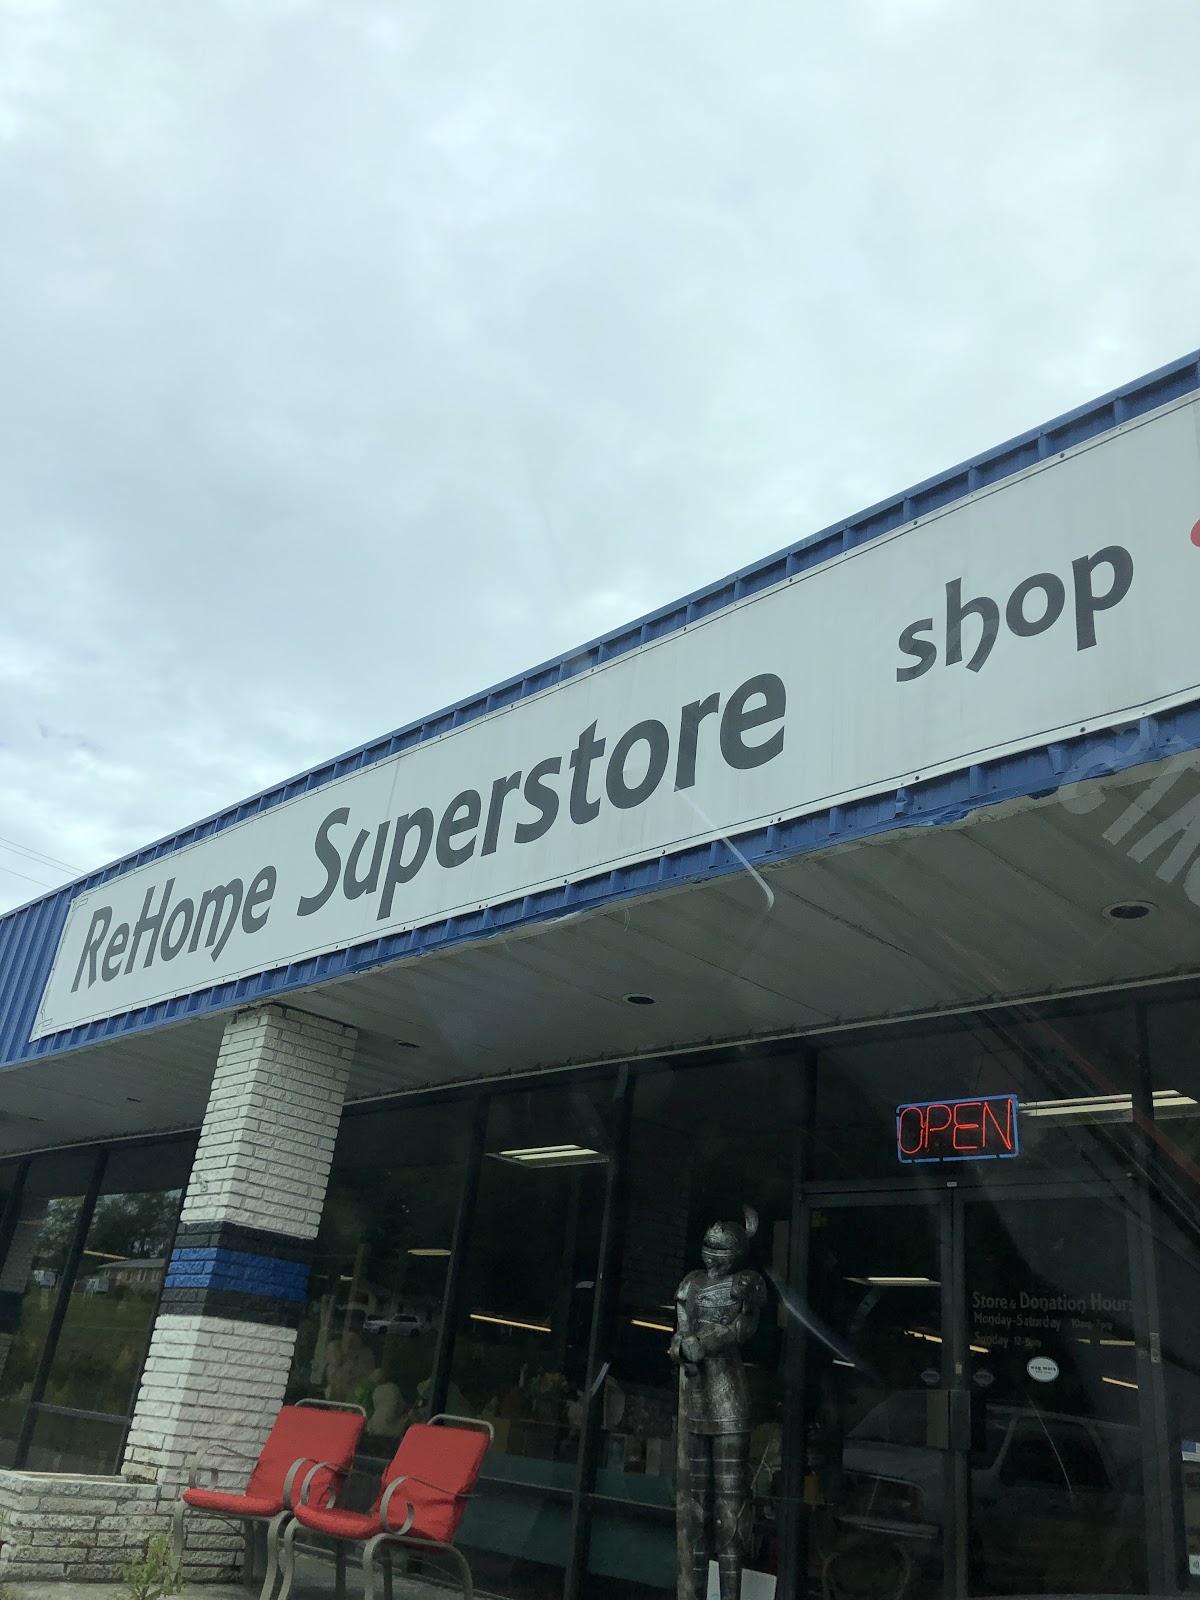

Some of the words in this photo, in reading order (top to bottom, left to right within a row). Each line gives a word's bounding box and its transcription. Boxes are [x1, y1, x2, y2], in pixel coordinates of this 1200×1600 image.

[897, 546, 1133, 681] shop
[71, 866, 276, 992] ReHome
[297, 674, 786, 920] Superstore
[898, 1099, 1013, 1155] OPEN
[972, 1291, 1008, 1309] Store
[1020, 1291, 1086, 1314] Donation
[1090, 1292, 1136, 1312] Hours
[975, 1331, 1009, 1349] Sunday
